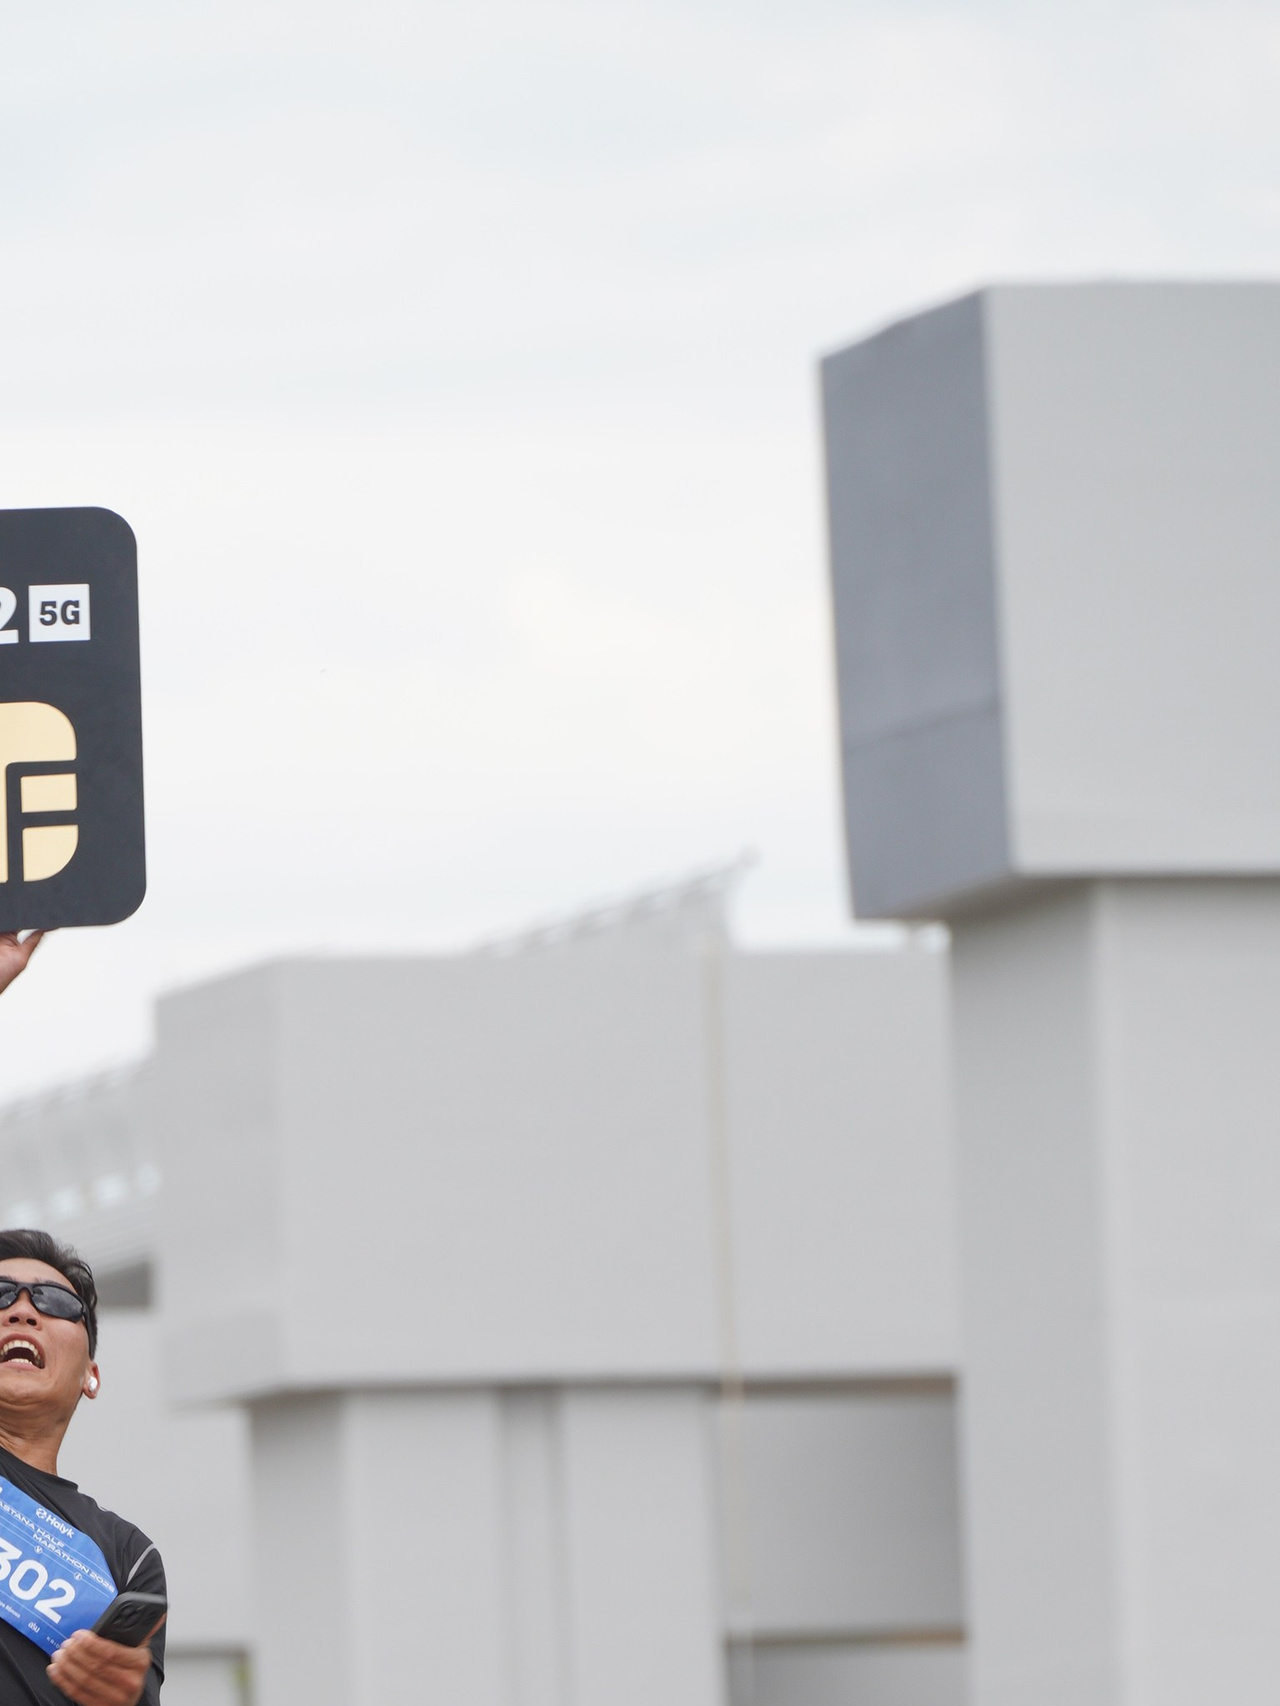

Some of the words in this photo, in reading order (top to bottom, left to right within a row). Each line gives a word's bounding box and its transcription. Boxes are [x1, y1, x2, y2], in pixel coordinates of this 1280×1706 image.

[39, 600, 80, 626] 5G
[36, 1528, 65, 1548] HALF
[46, 1514, 75, 1539] Halyk
[32, 1533, 90, 1574] MARATHON
